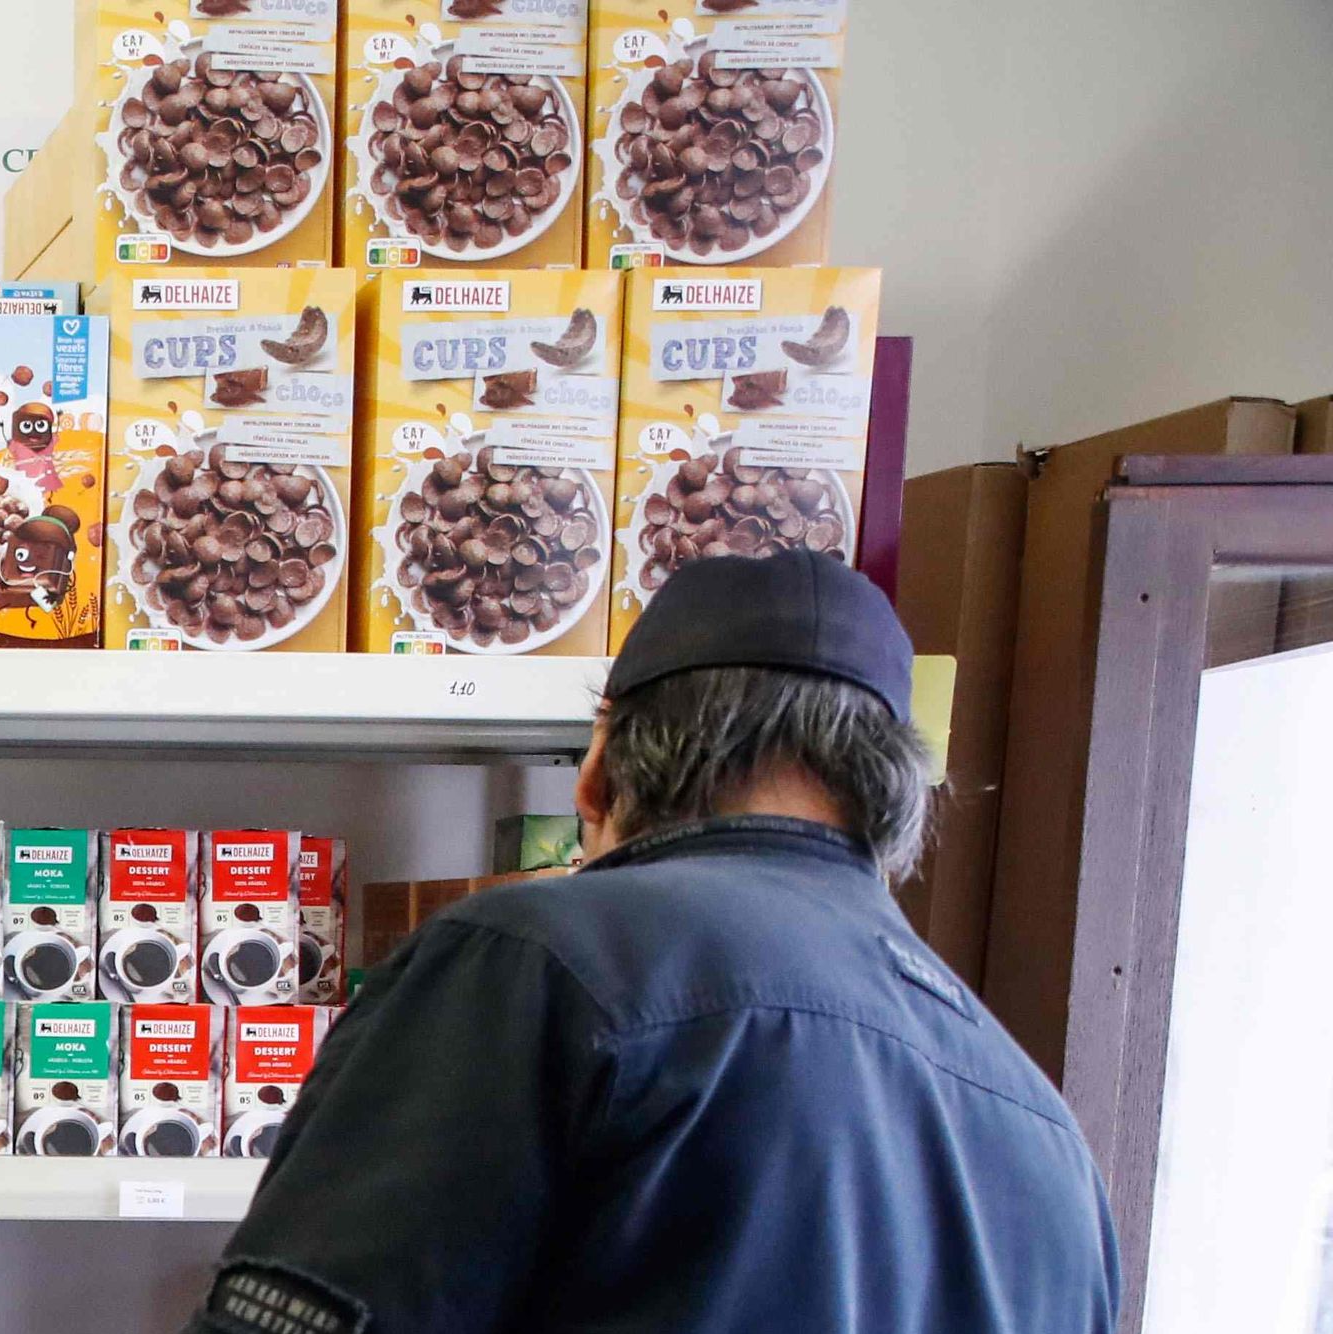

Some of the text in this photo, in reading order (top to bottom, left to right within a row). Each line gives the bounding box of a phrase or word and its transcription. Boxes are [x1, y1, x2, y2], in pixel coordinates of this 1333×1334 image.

[165, 285, 233, 305] DELHAIZE
[435, 285, 503, 307] DELHAIZE
[686, 283, 756, 307] DELHAIZE
[143, 336, 236, 369] CUPS
[413, 338, 507, 371] CUPS
[661, 335, 757, 372] CUPS
[132, 848, 169, 858] DELHAIZE
[34, 869, 63, 877] MOKA
[150, 1044, 191, 1052] DESSERT
